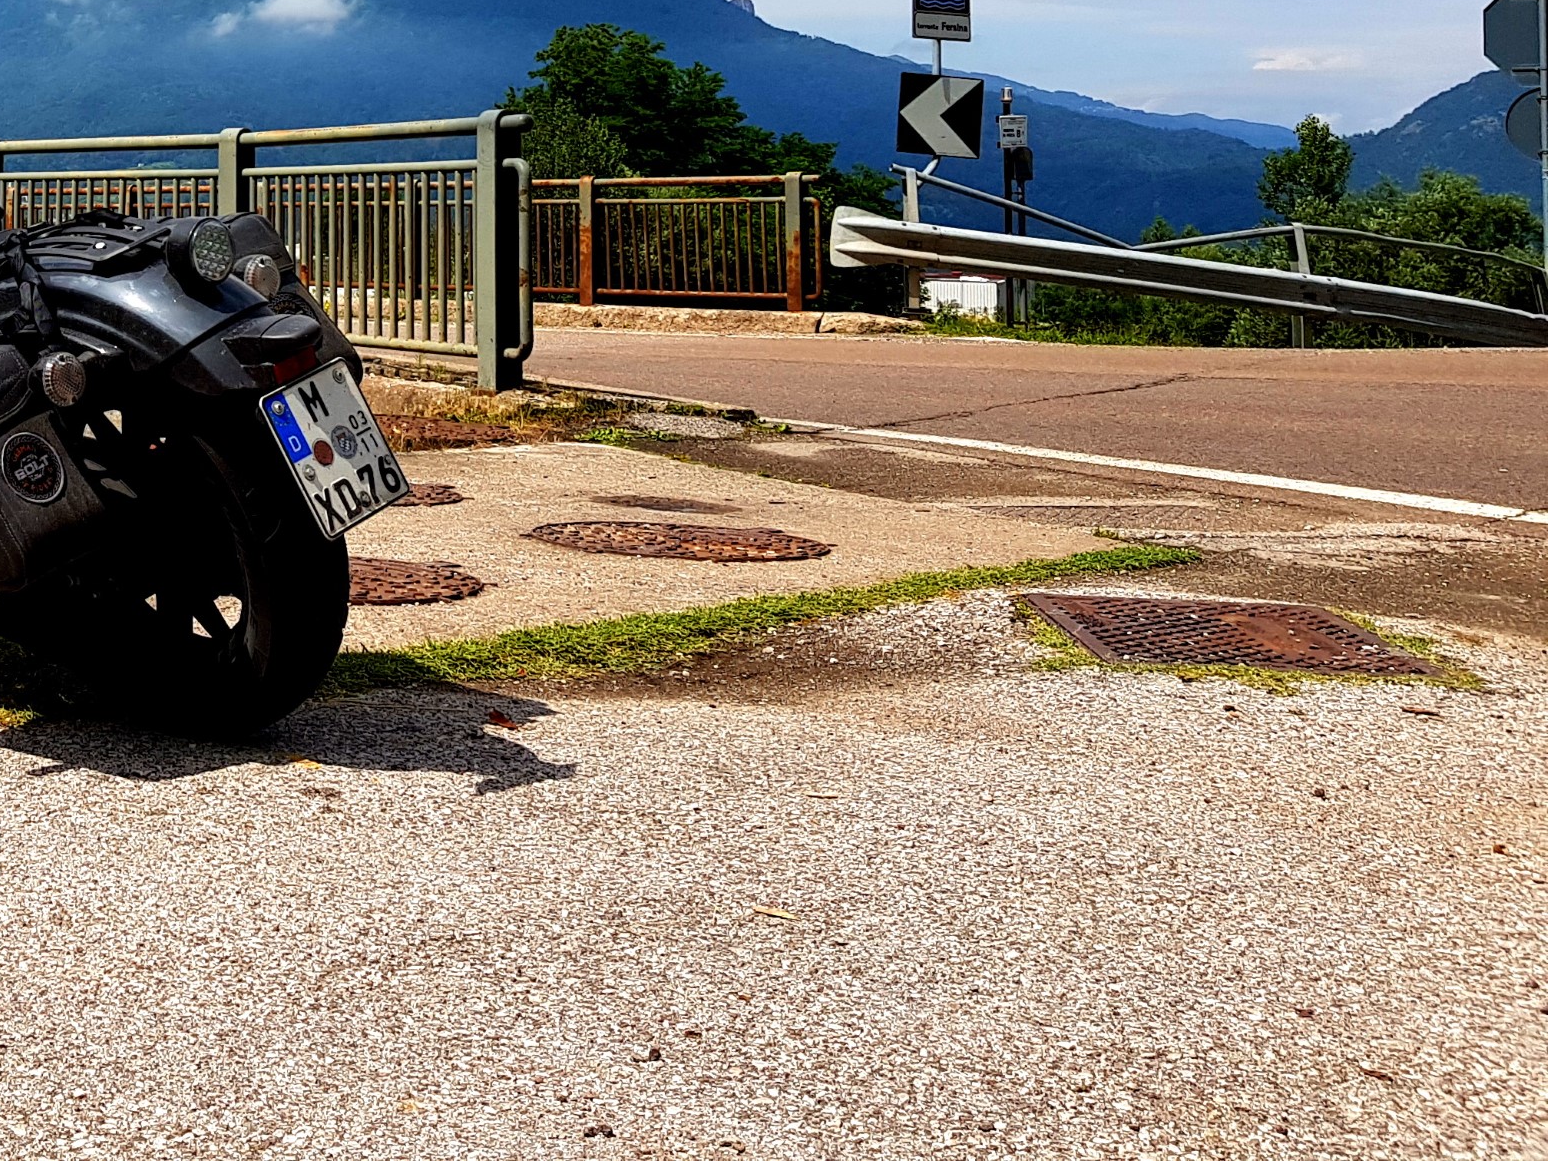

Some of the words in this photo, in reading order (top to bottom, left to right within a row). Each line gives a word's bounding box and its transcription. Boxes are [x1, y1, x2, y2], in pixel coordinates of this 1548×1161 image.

[941, 21, 968, 32] Fersina
[297, 380, 329, 423] M
[348, 410, 368, 430] 03
[287, 435, 302, 453] D
[13, 454, 49, 481] BOLT
